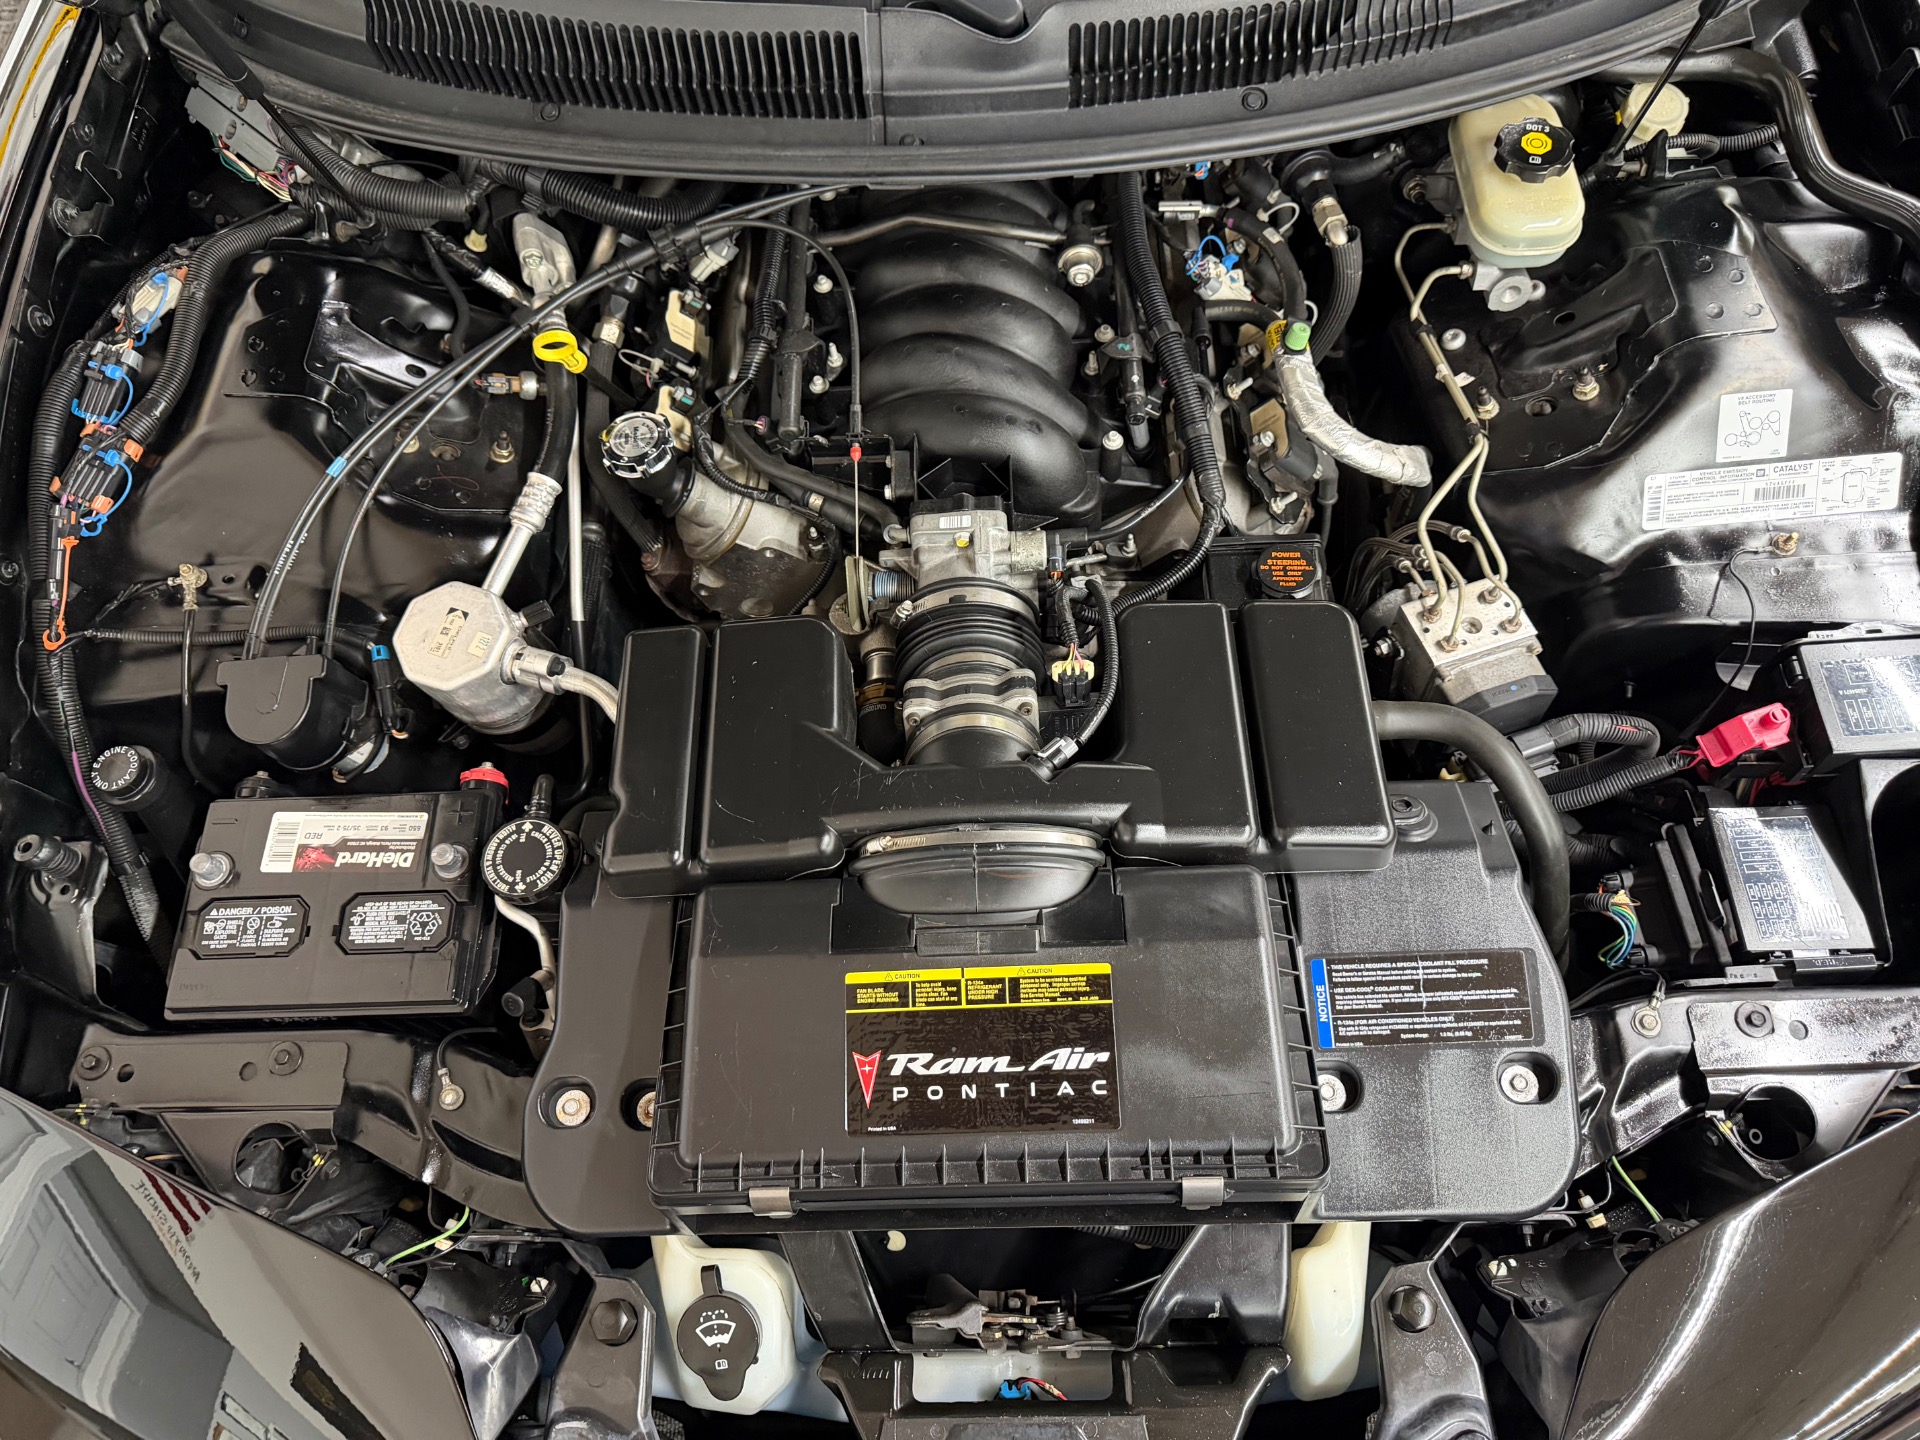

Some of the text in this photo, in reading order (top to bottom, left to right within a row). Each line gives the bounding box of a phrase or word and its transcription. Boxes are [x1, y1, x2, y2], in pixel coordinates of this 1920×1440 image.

[1526, 124, 1543, 132] DOT
[1699, 466, 1748, 478] VEHICLE EMISSION
[1773, 462, 1814, 474] CATALYST
[1692, 475, 1717, 483] CONTROL
[1719, 470, 1755, 480] INFORMATION
[91, 746, 138, 790] ENGINE COOLANT ONLY
[499, 824, 517, 840] ALIGN
[531, 831, 548, 844] CHECK
[486, 839, 500, 862] ARROW
[536, 825, 563, 887] NEVER OPEN HOT
[544, 842, 552, 858] LEVEL
[335, 852, 415, 868] DieHard
[486, 865, 496, 881] VENT
[526, 866, 547, 882] BOTTLE
[495, 878, 511, 892] TUBE
[218, 907, 253, 915] DANGER
[261, 906, 292, 914] POISON
[1316, 985, 1328, 1022] NOTICE
[887, 1047, 1110, 1075] Ram Air
[893, 1080, 1107, 1101] PONTIAC
